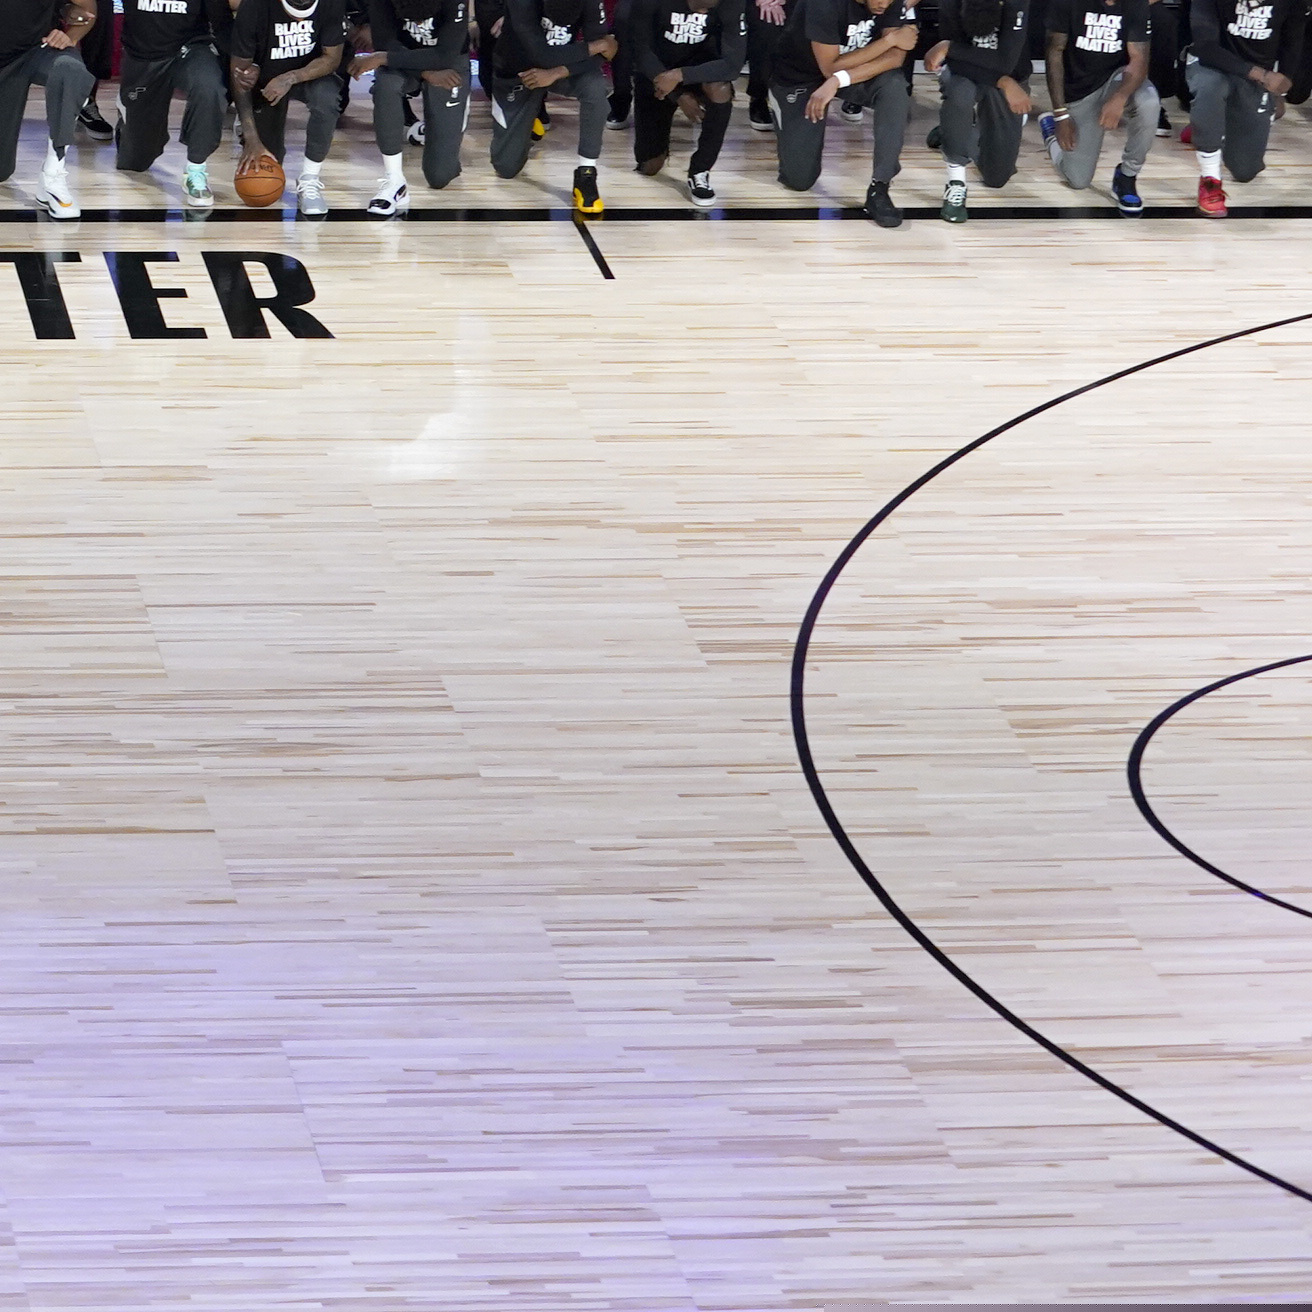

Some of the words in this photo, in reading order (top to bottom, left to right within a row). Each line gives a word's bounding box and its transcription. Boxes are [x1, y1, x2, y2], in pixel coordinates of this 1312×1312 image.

[670, 12, 708, 26] BLACK
[1084, 12, 1122, 29] BLACK
[1237, 15, 1268, 29] LIVES
[274, 20, 315, 36] BLACK
[673, 24, 703, 36] LIVES
[1086, 25, 1118, 40] LIVES
[278, 33, 312, 48] LIVES
[270, 41, 316, 59] MATTE
